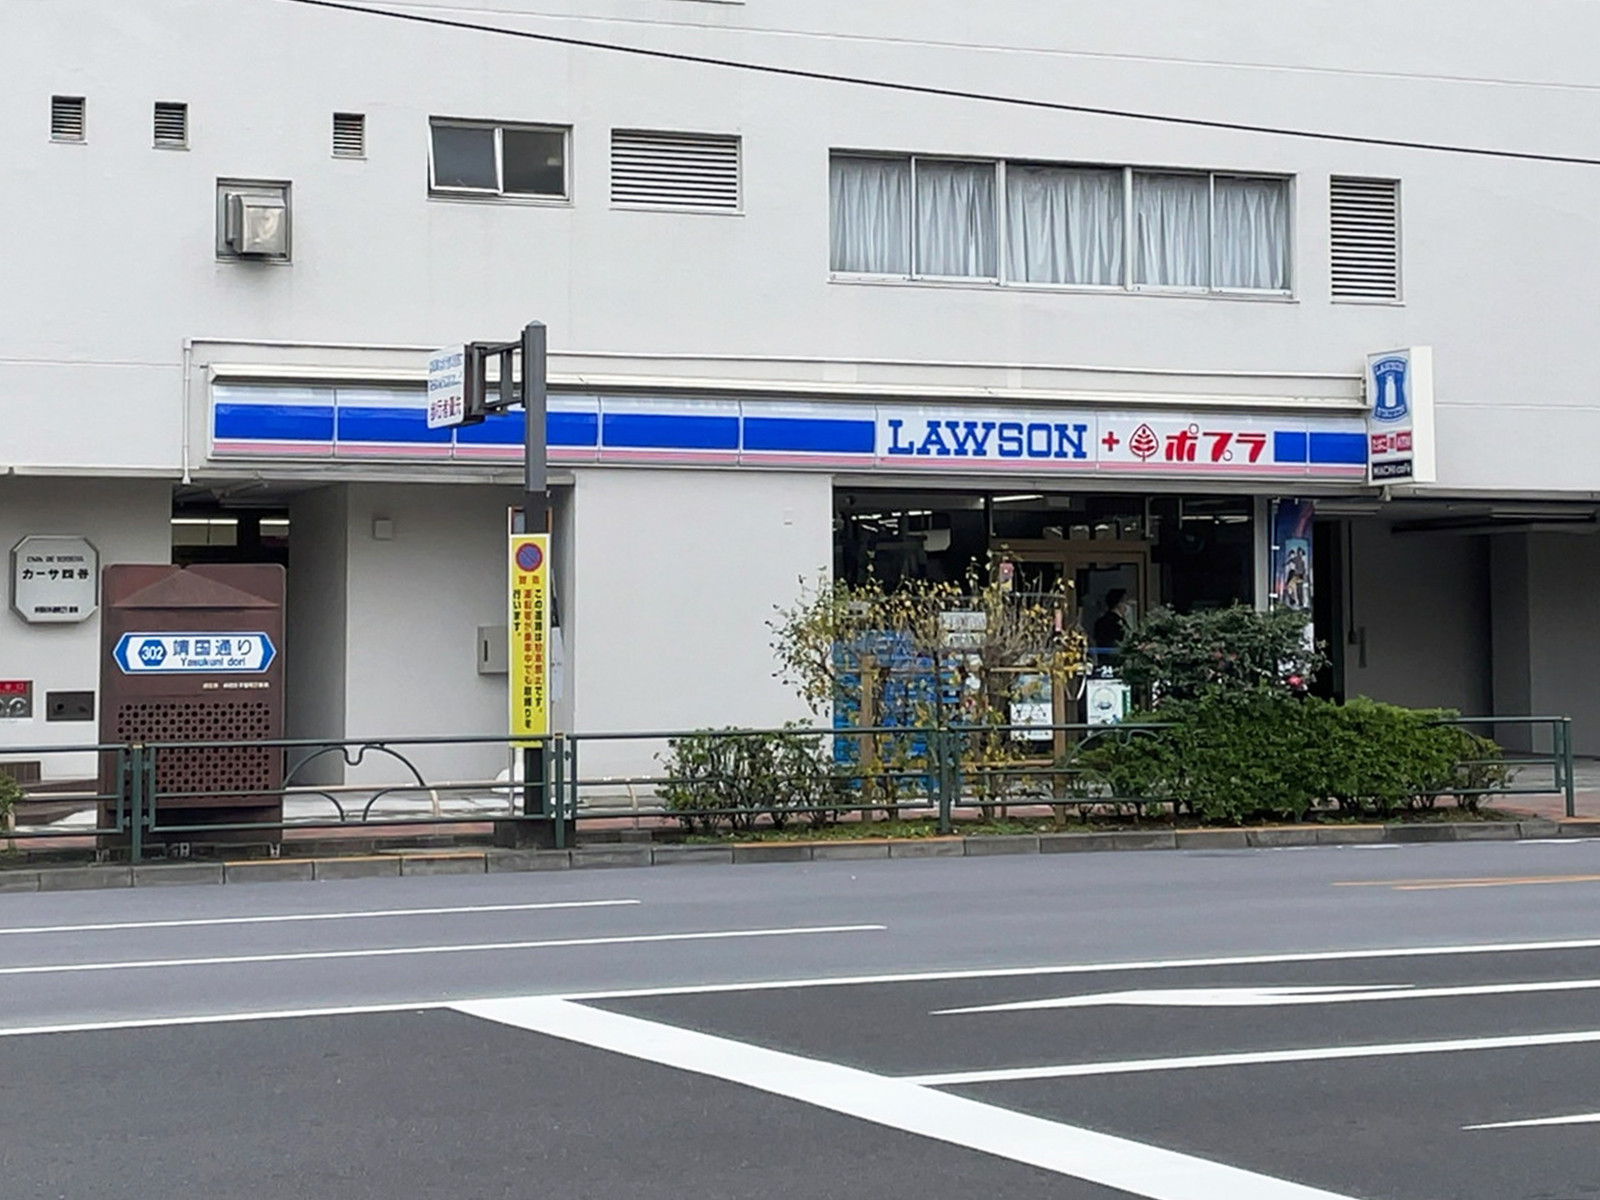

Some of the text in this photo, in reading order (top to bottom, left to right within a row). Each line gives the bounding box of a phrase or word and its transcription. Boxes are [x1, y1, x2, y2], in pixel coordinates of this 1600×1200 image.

[888, 419, 1087, 458] LAWSON
[1165, 422, 1266, 462] ポプラ
[22, 568, 89, 580] カーサ四谷
[141, 646, 164, 661] 302
[172, 639, 252, 656] 靖国通り
[180, 657, 246, 667] Yasukuni dori
